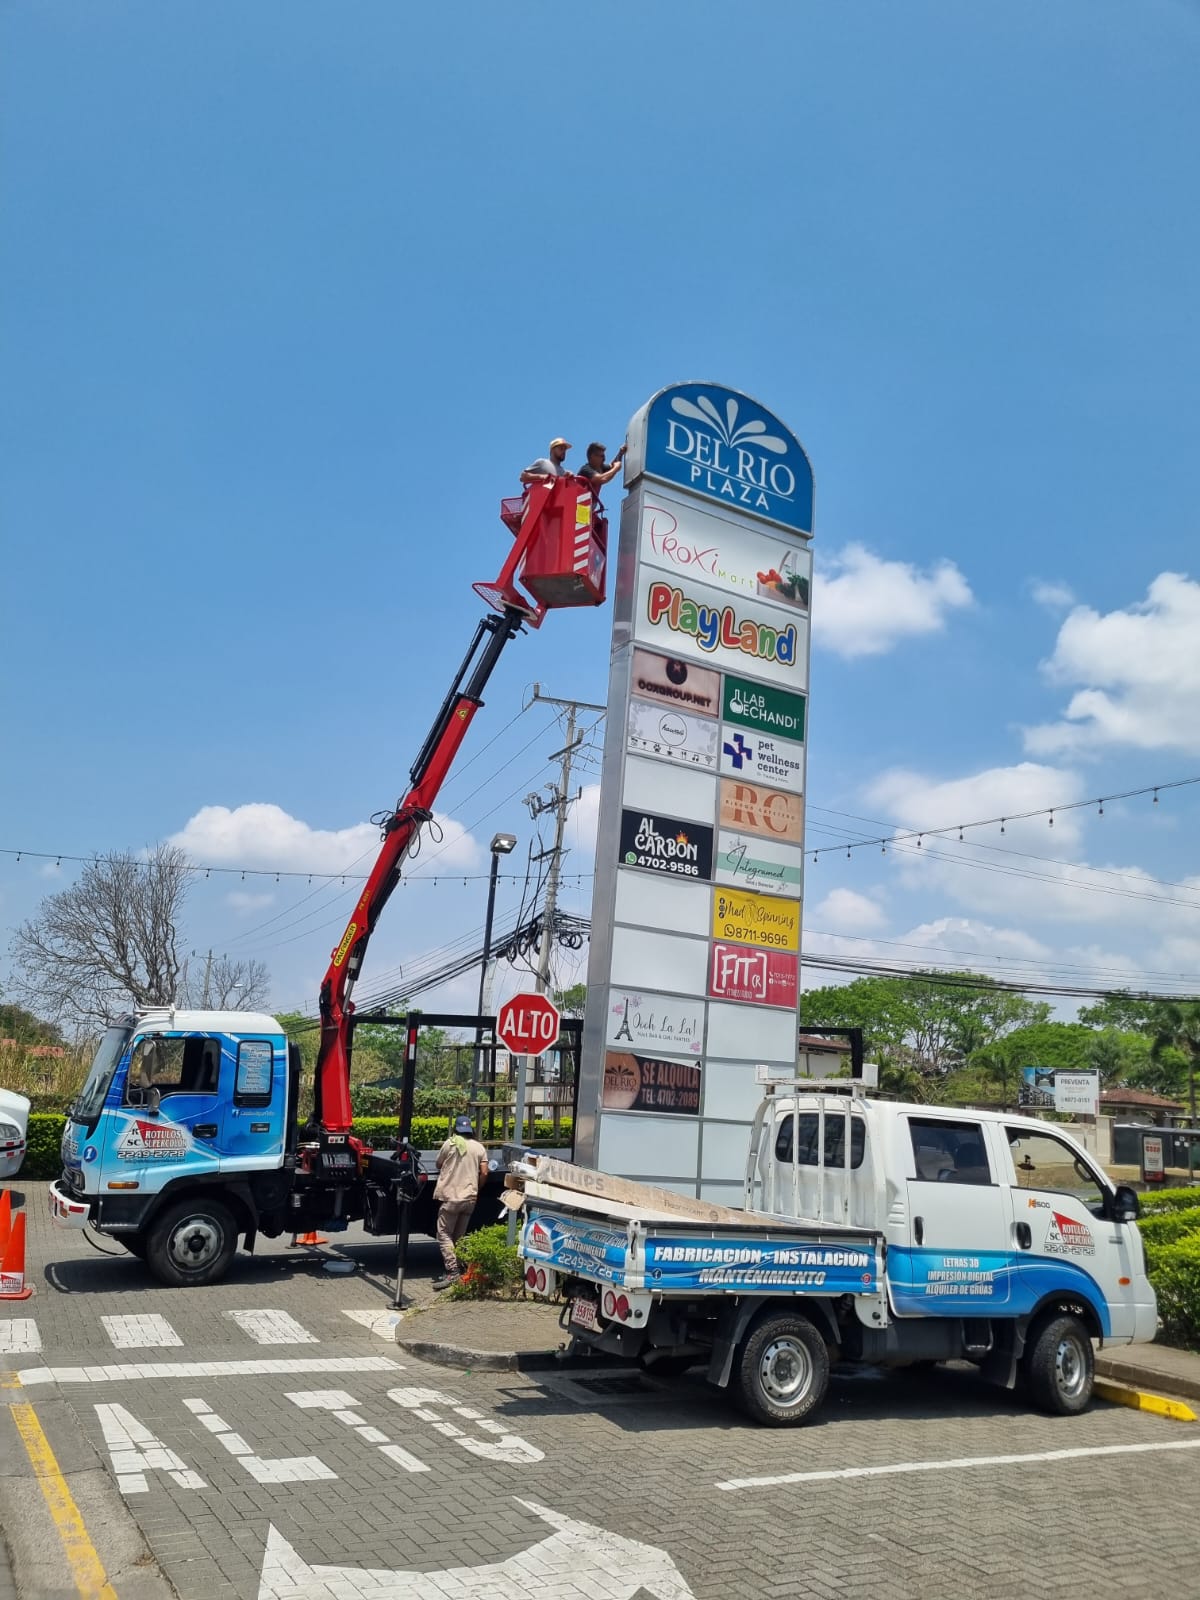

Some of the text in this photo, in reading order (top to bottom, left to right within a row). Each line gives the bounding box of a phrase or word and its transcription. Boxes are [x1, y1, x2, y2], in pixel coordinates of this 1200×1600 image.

[666, 419, 795, 497] DEL RIO
[691, 464, 769, 511] PLAZA
[743, 691, 765, 708] LAB
[743, 704, 797, 729] ECHANDI
[758, 740, 775, 751] pet
[757, 762, 789, 776] center
[758, 752, 800, 769] wellness
[639, 817, 659, 837] AL
[634, 833, 697, 861] CARBON
[638, 855, 699, 875] 4702-9586
[726, 845, 785, 880] Integramed
[756, 906, 794, 930] Spinning
[735, 927, 788, 946] 8711-9696
[501, 1008, 554, 1040] ALTO
[660, 1015, 674, 1033] La
[620, 1077, 636, 1087] RIO
[643, 1062, 699, 1089] SE ALQUILA
[117, 1150, 186, 1160] 2249-2728
[1050, 1233, 1061, 1241] SC
[654, 1246, 762, 1264] FABRICACIÓN
[943, 1257, 979, 1268] LETRAS 3D
[558, 1252, 613, 1278] 2249-2728
[698, 1268, 827, 1286] MANTENIMIENTO
[968, 1271, 994, 1282] DIGITAL
[925, 1284, 959, 1296] ALQUILER
[959, 1284, 968, 1295] DE
[94, 1387, 546, 1493] ALTO
